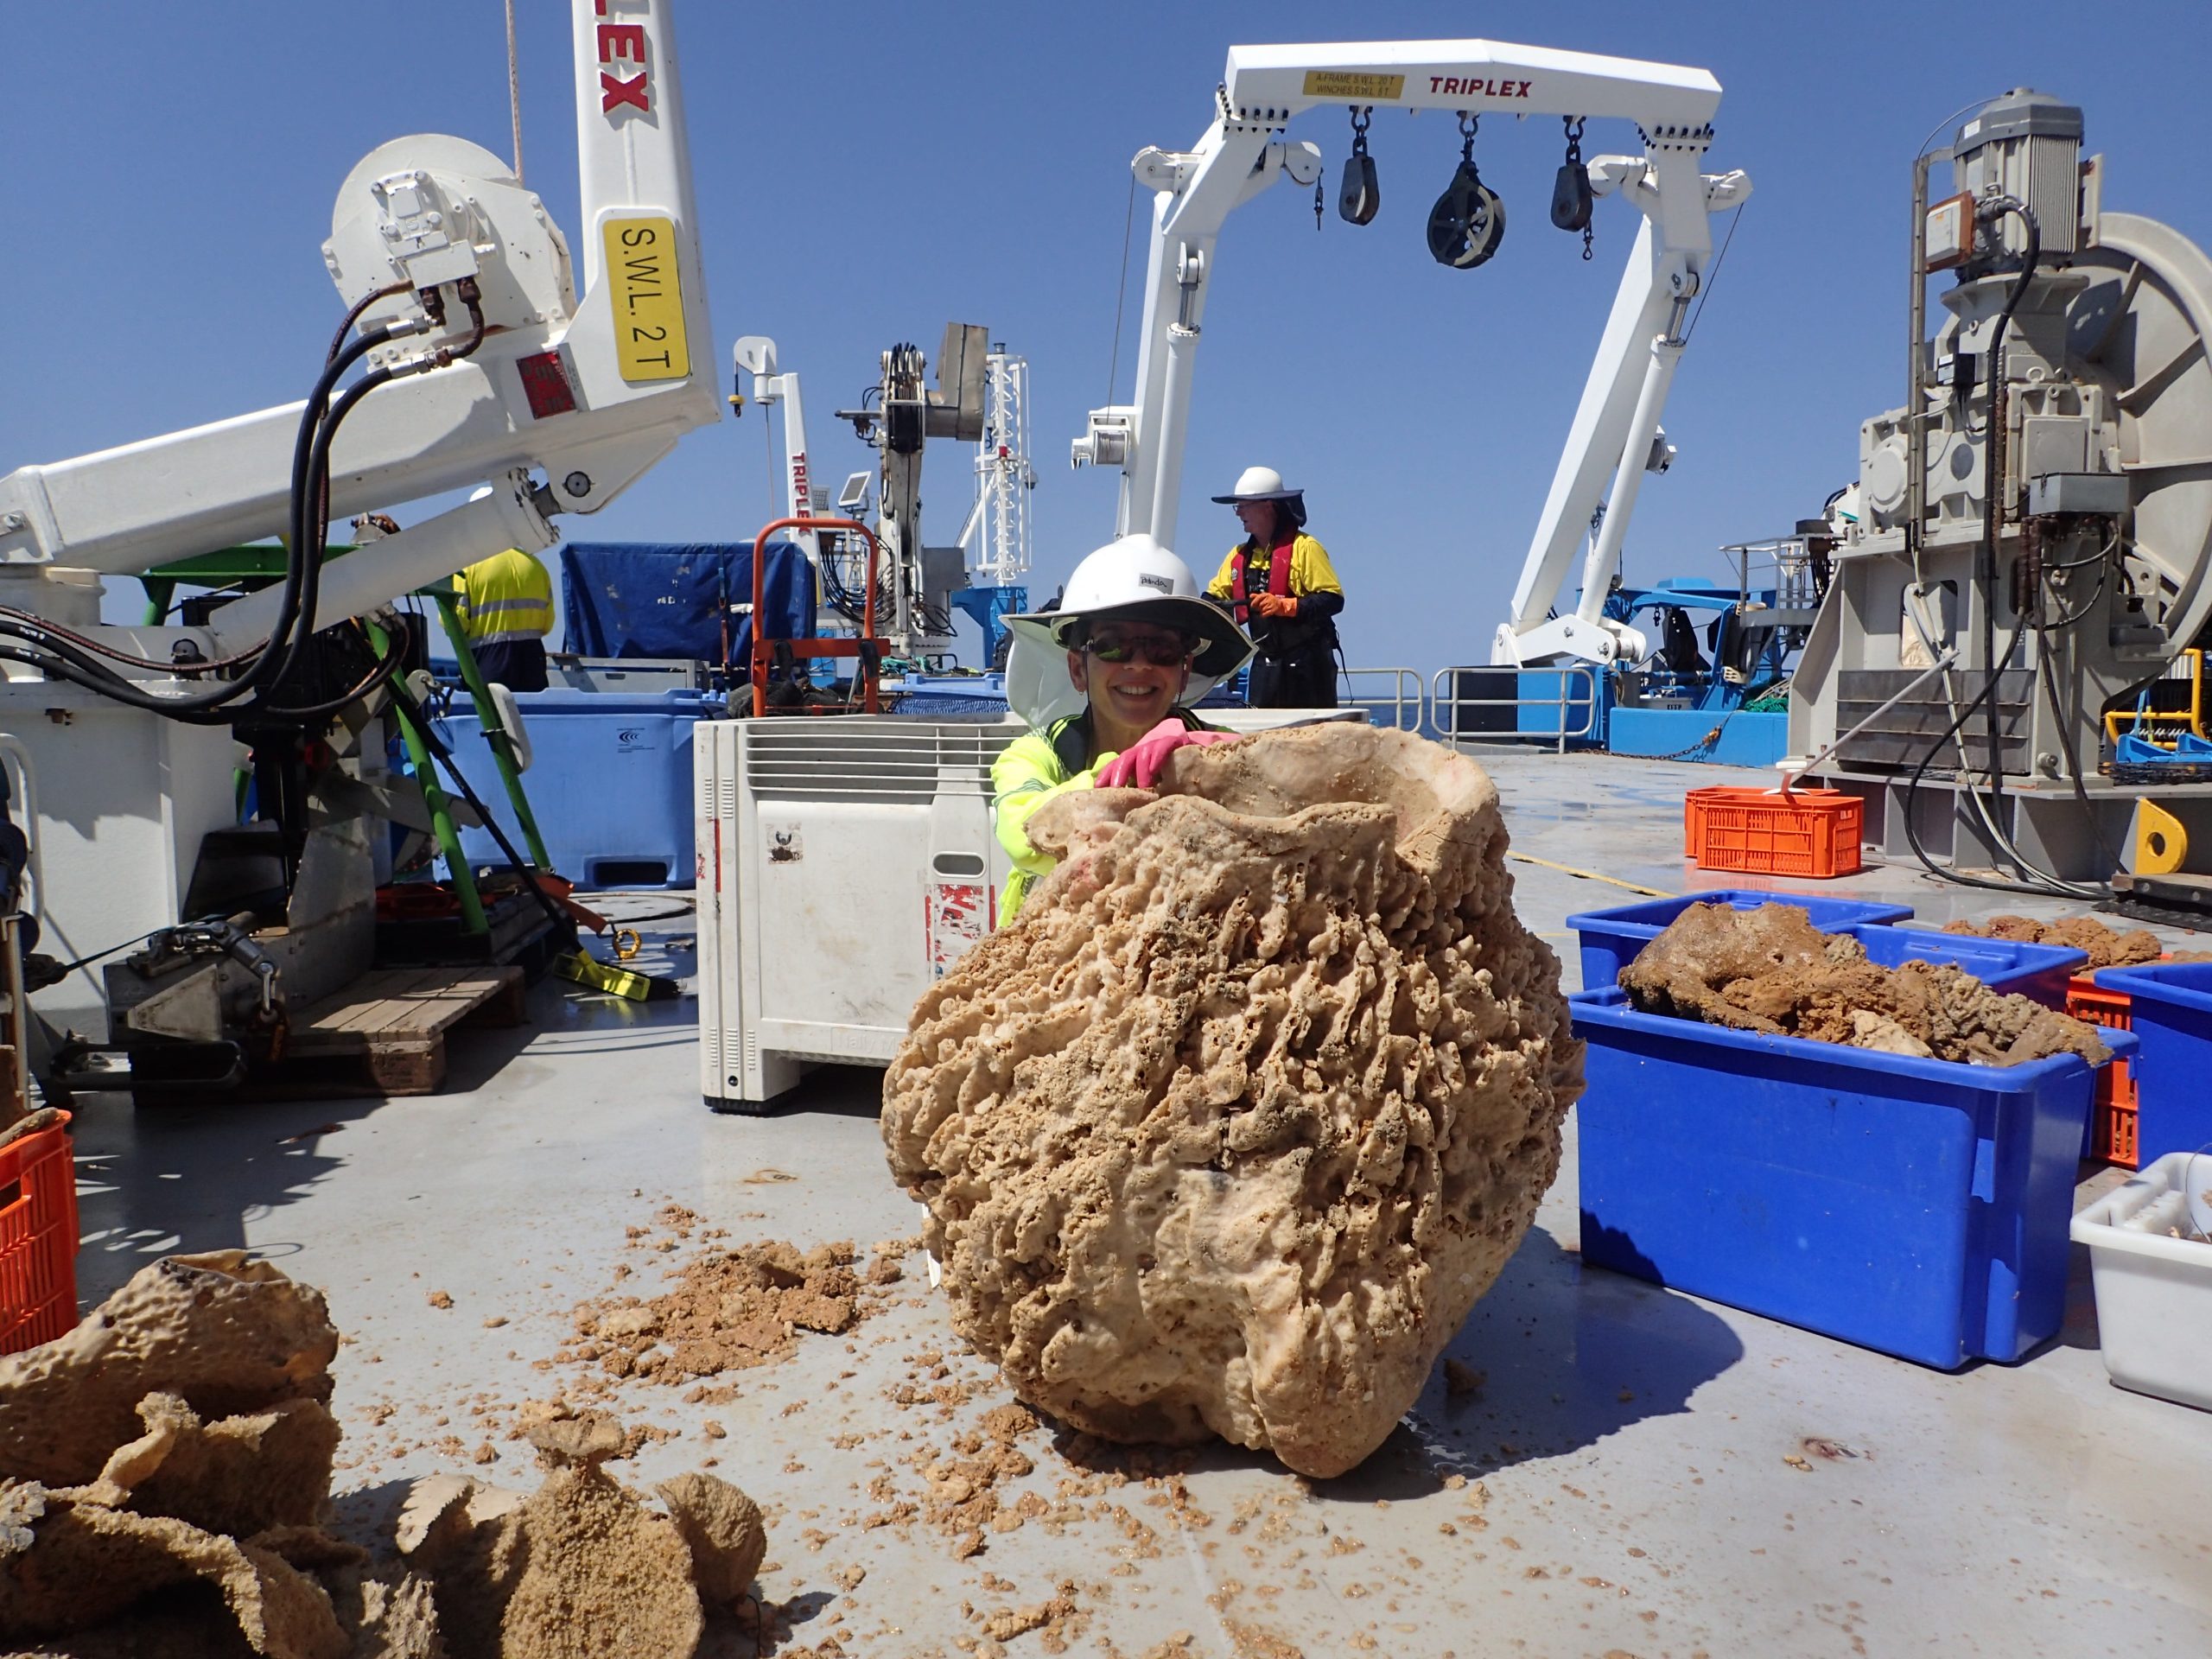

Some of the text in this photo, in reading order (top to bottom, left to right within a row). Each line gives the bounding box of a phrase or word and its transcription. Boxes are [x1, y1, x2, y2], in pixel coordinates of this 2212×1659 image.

[1378, 75, 1388, 85] 20
[1389, 76, 1395, 86] T
[1430, 77, 1532, 98] TRIPLEX
[1317, 85, 1352, 95] WINCHES
[1384, 87, 1389, 97] T
[621, 228, 671, 368] S.W.L. 2 T
